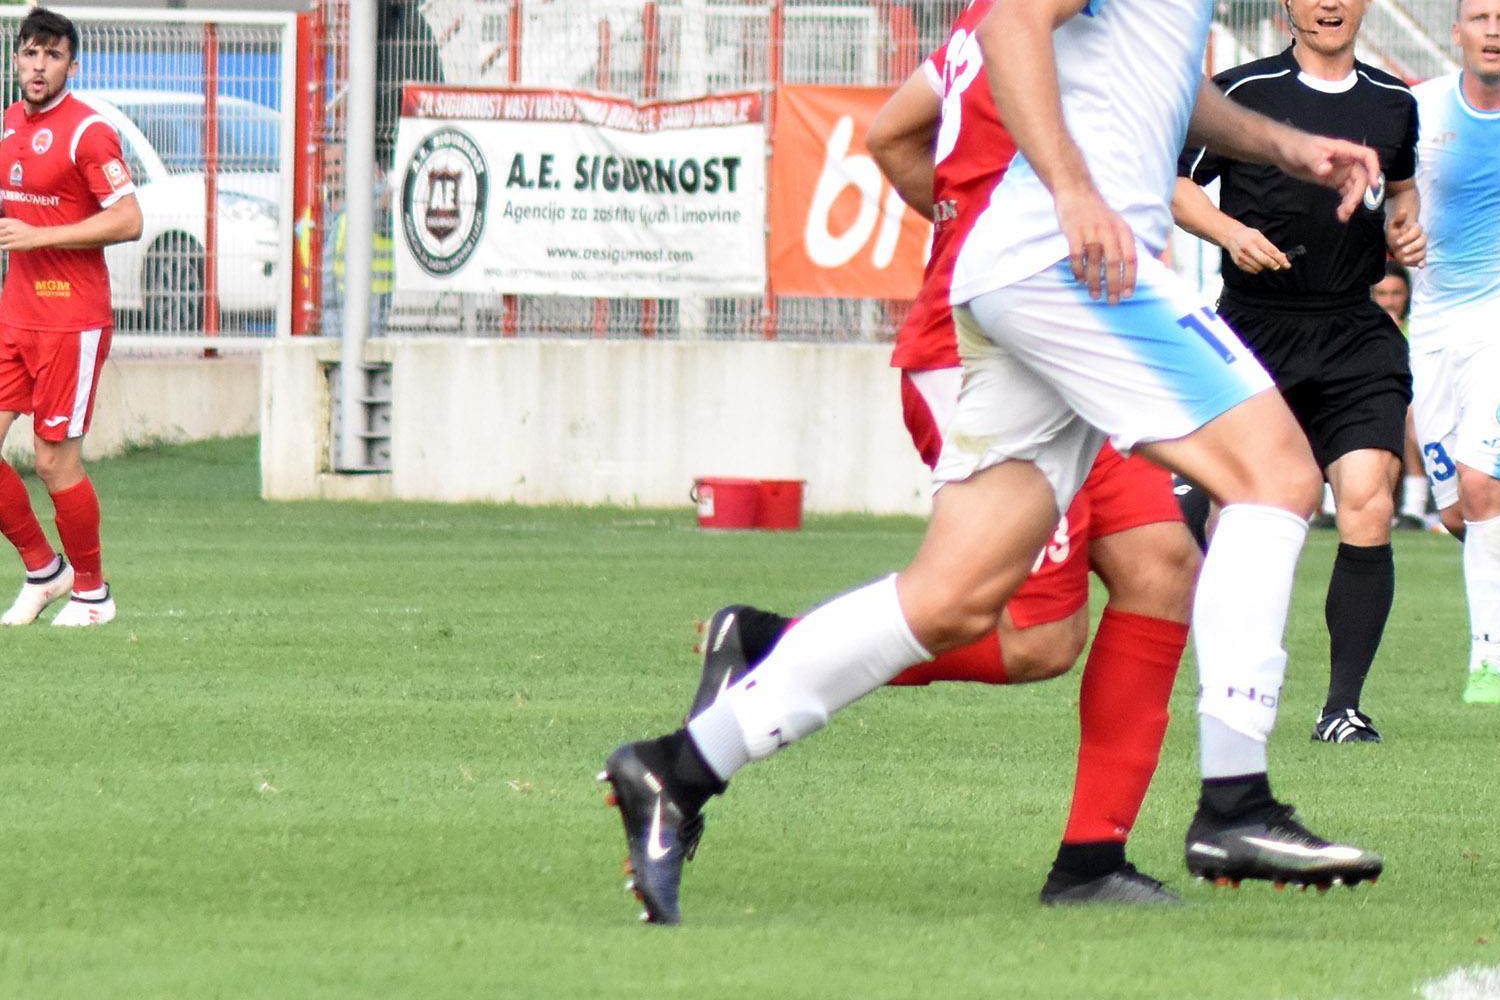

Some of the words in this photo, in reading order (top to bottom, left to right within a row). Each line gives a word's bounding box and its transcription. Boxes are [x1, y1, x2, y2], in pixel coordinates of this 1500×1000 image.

[505, 152, 560, 190] A.E.
[574, 154, 742, 195] SIGURNOST
[503, 200, 565, 223] Agencija
[572, 207, 588, 222] za
[682, 205, 742, 224] imovine
[546, 246, 695, 266] www.aesigurnost.com
[1423, 441, 1457, 482] 3
